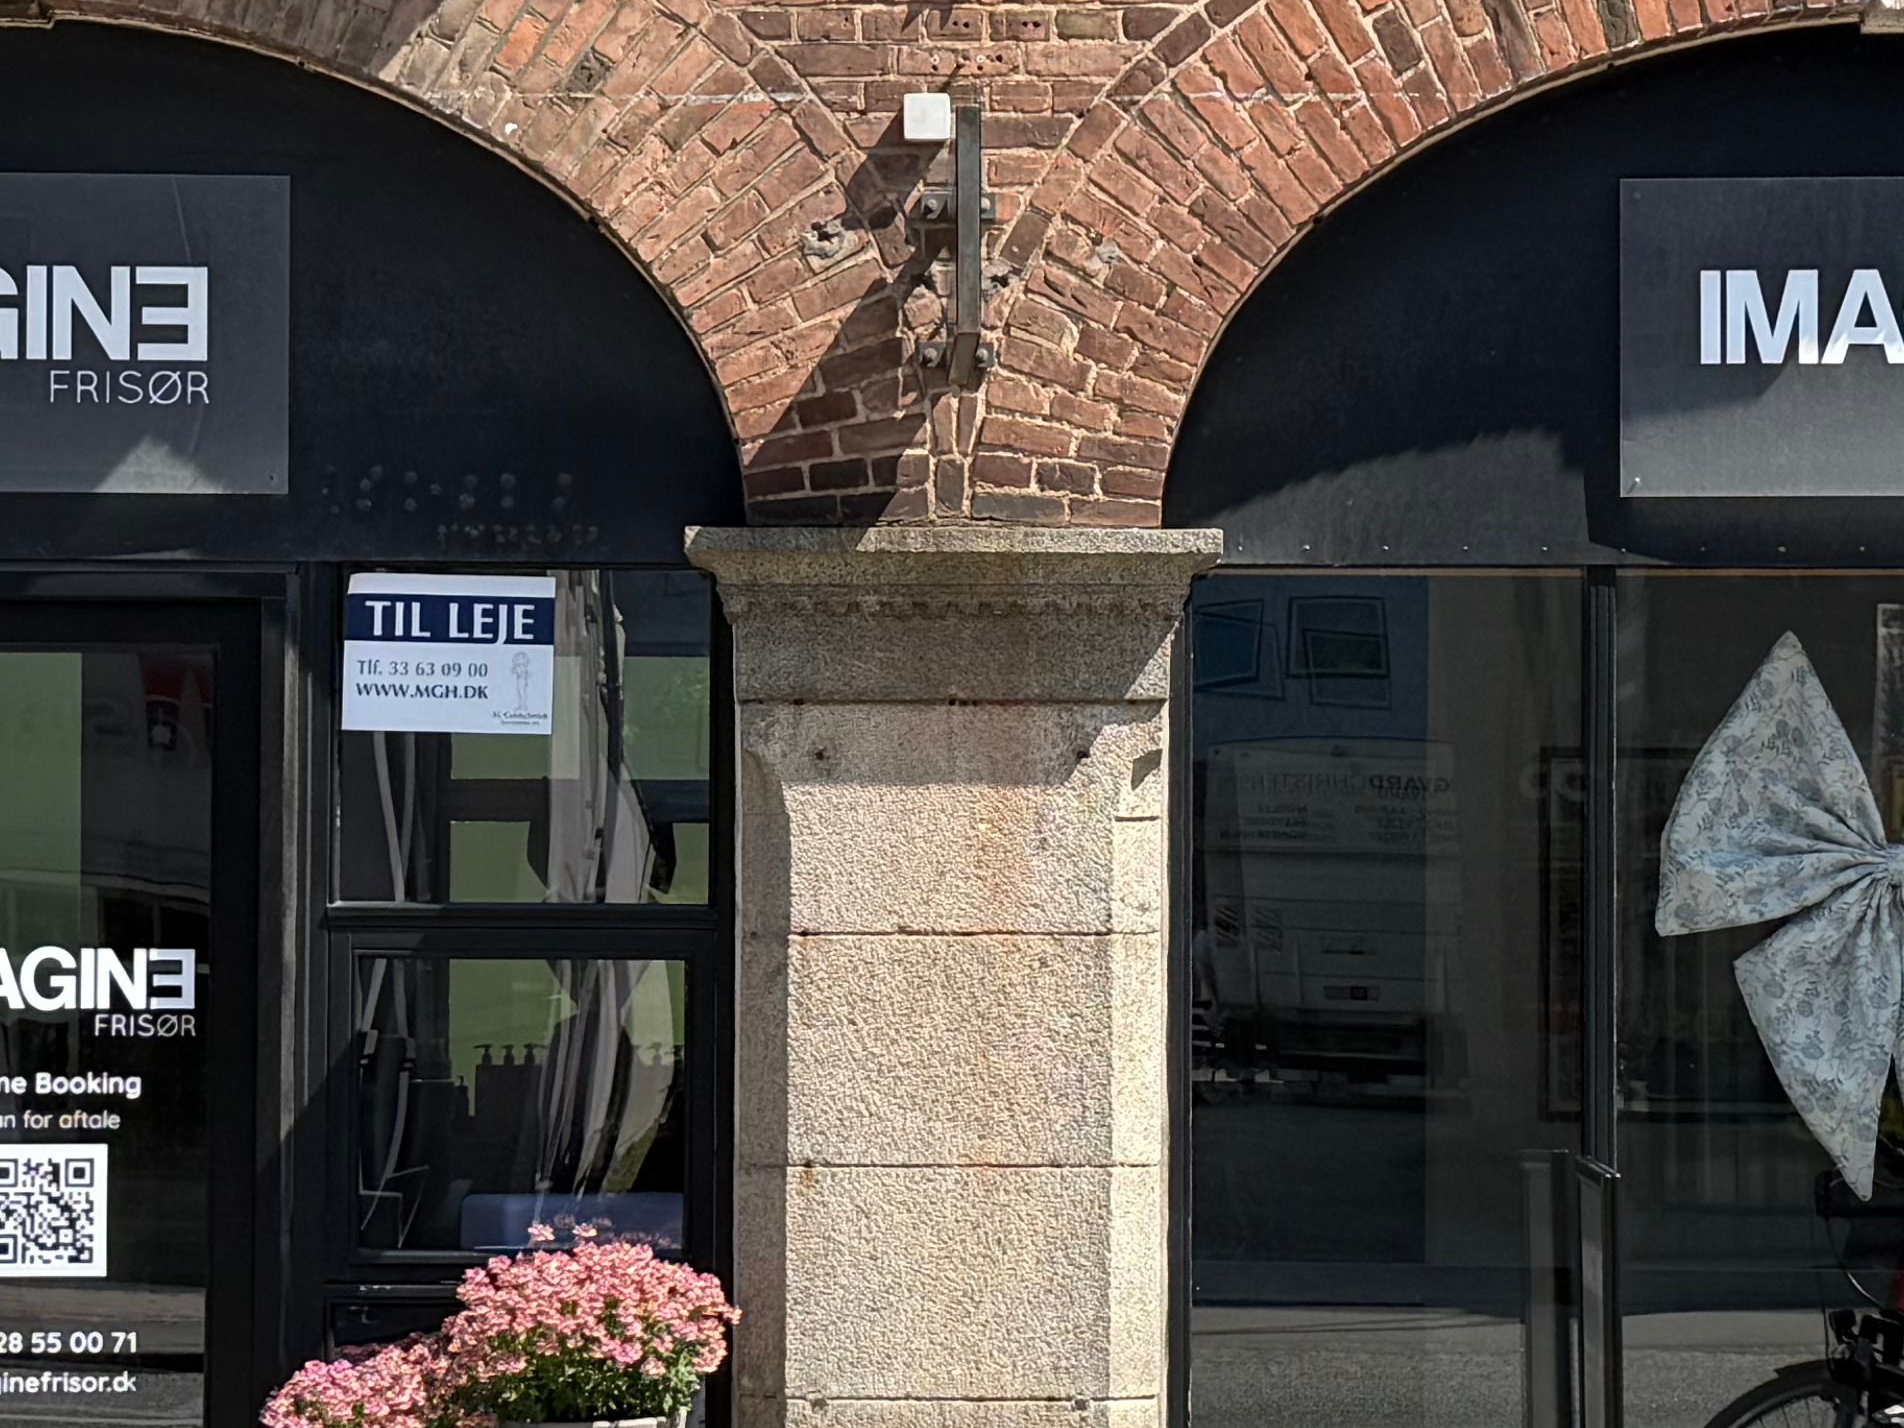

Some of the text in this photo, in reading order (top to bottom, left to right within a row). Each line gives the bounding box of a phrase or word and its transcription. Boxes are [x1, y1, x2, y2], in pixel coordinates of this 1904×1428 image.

[49, 370, 210, 405] FRISØR
[364, 600, 536, 645] TIL LEJE
[356, 660, 489, 678] Tlf. 33 63 09 00
[356, 682, 489, 700] WWW.MGH.DK
[94, 1014, 196, 1037] FRISØR
[34, 1071, 142, 1100] Booking
[22, 1109, 54, 1130] for
[59, 1109, 121, 1130] aftale
[31, 1331, 62, 1354] 55
[70, 1331, 104, 1354] 00
[111, 1331, 137, 1353] 71
